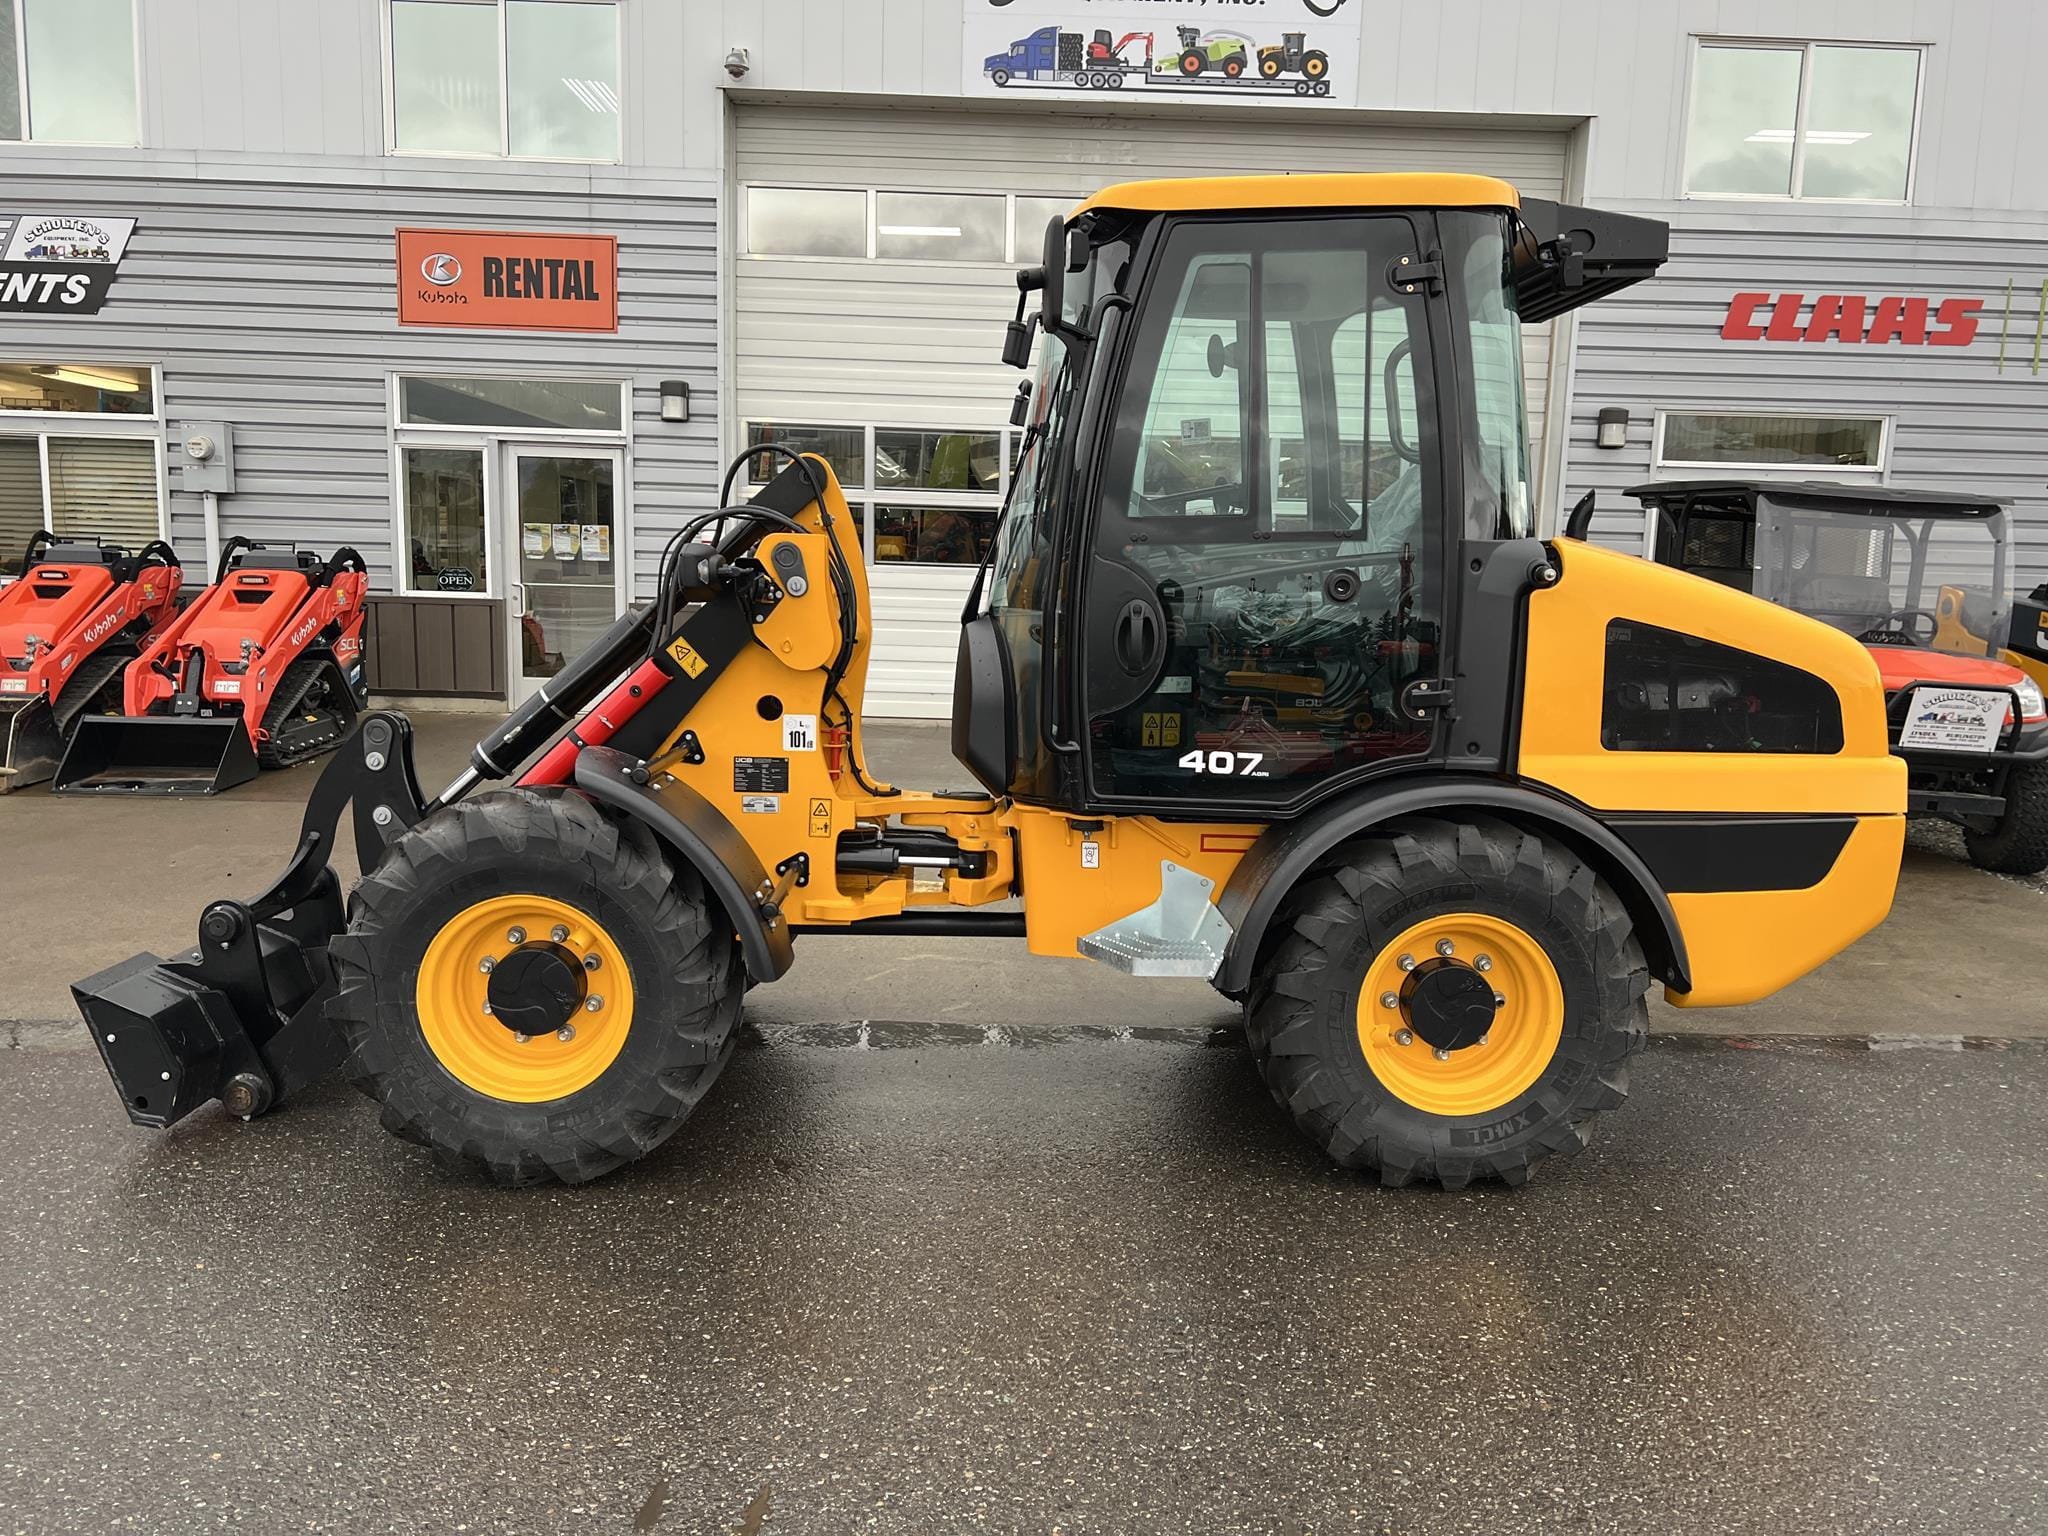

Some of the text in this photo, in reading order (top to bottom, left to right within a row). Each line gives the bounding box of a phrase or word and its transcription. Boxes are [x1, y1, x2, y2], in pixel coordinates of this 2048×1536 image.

[24, 217, 110, 245] SCHOLTEN'S
[483, 256, 599, 301] RENTAL
[418, 290, 467, 304] Kubota
[1720, 292, 1985, 346] CLAAS
[439, 576, 473, 584] OPEN
[83, 613, 117, 643] Kubota
[291, 617, 317, 646] Kubota
[788, 730, 806, 748] 101
[1178, 749, 1264, 776] 407
[1468, 1112, 1531, 1144] XMCL
